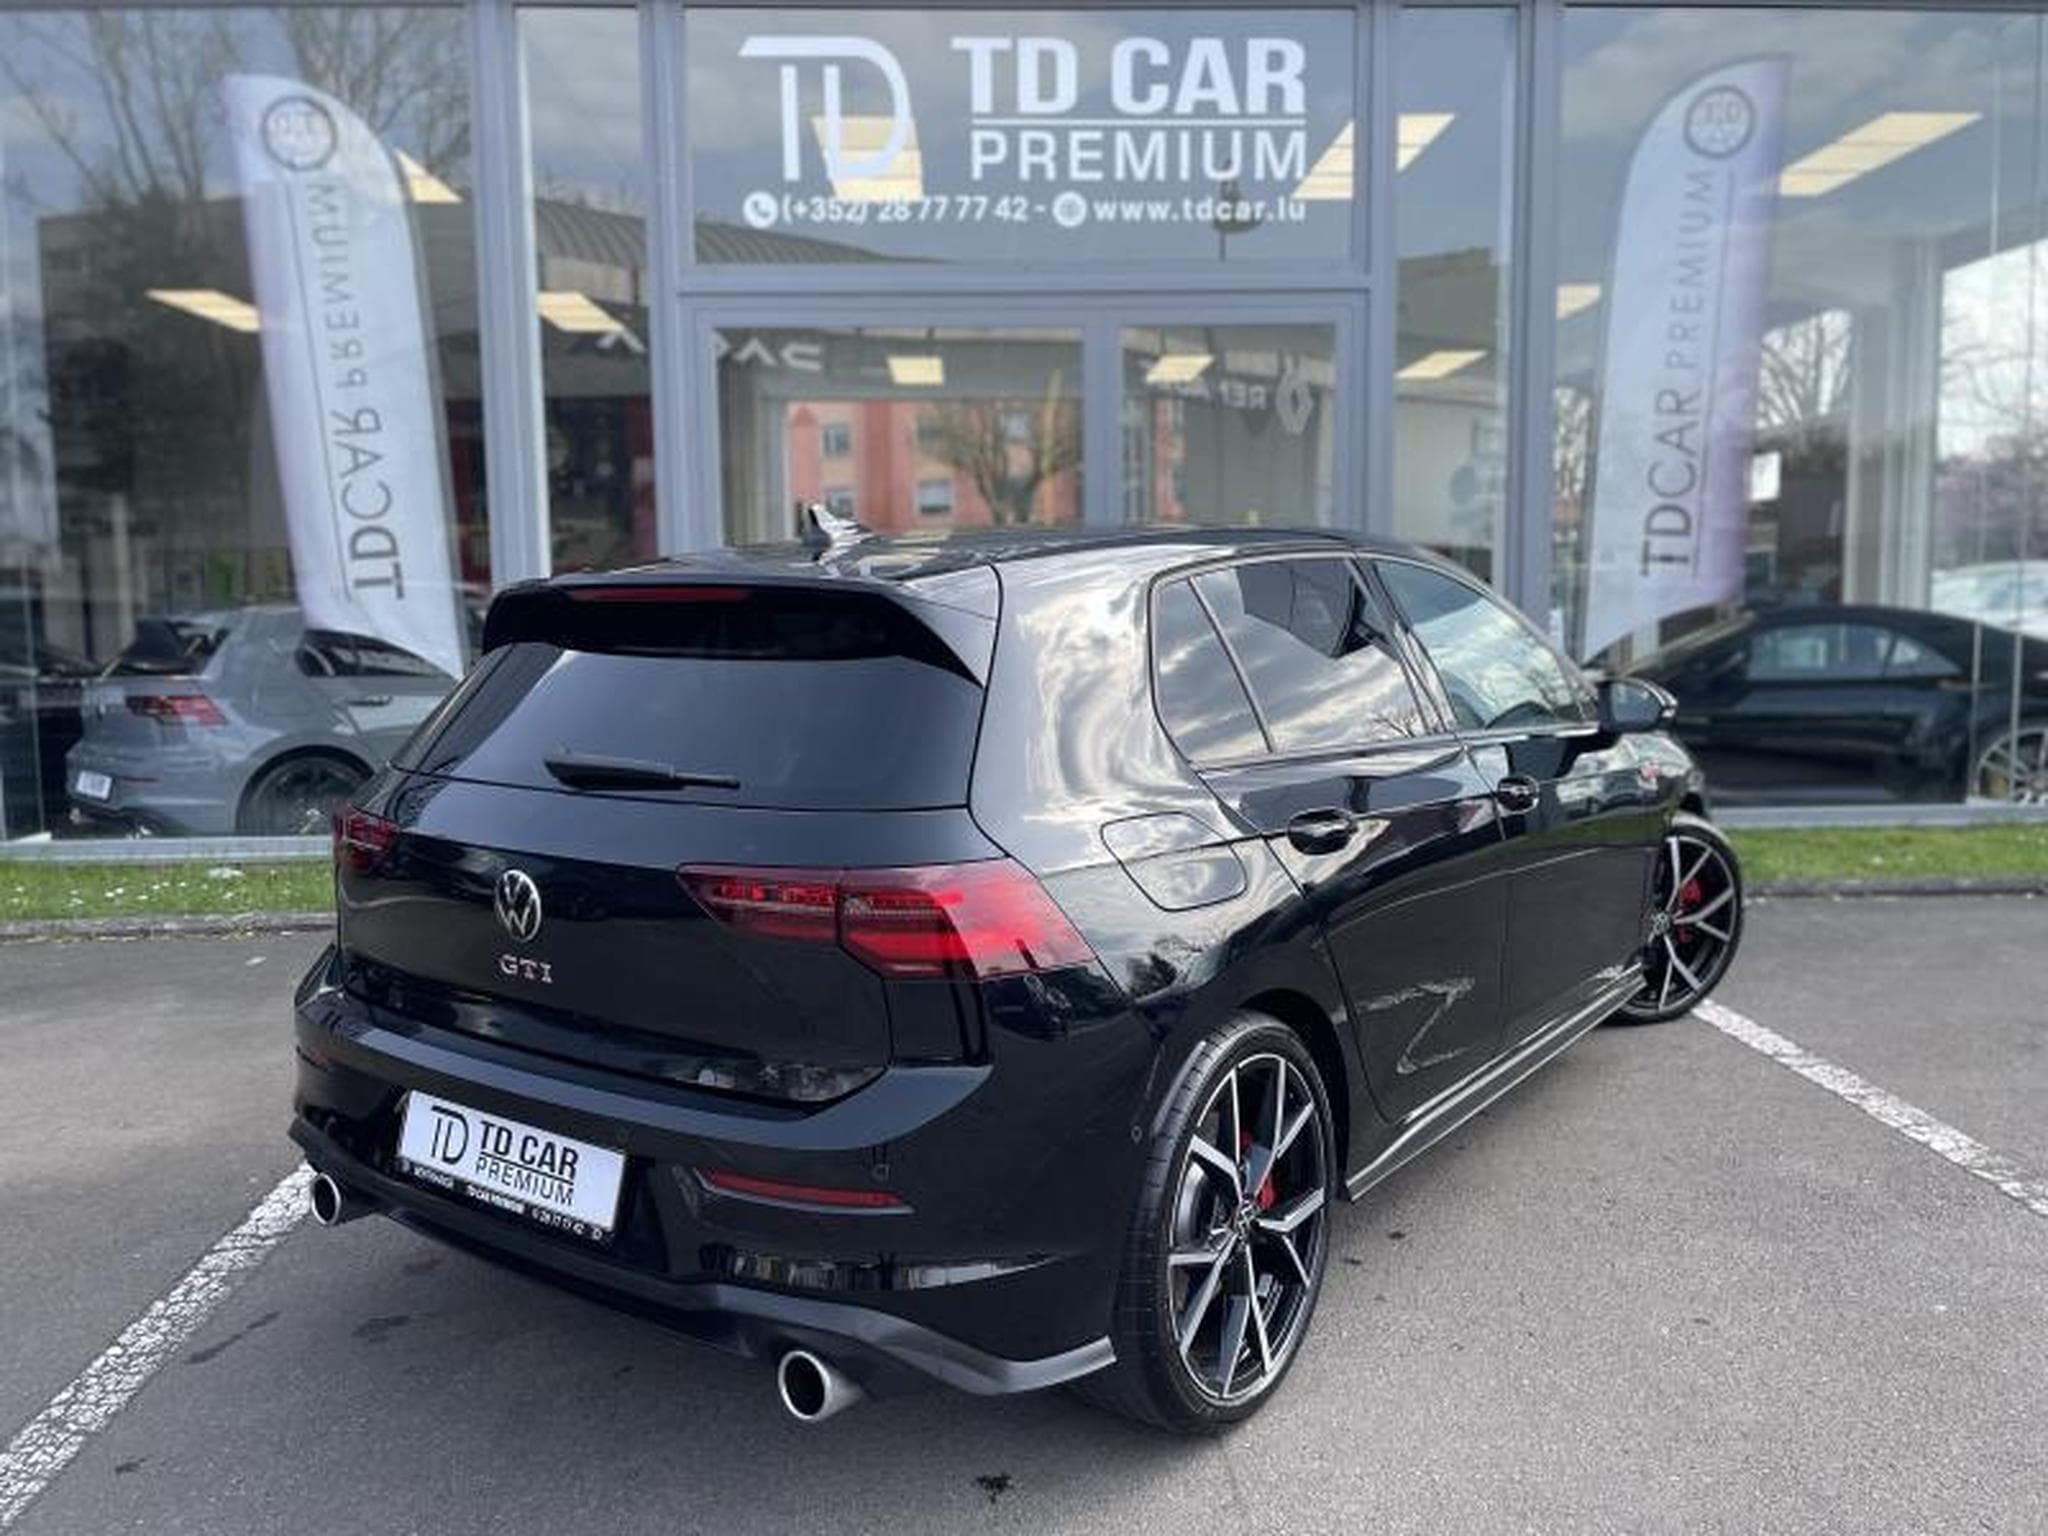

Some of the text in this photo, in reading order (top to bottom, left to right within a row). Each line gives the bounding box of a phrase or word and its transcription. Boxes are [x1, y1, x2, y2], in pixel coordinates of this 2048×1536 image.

[950, 36, 1306, 114] TD CAR
[971, 129, 1307, 181] PREMIUM
[955, 196, 988, 220] 77
[995, 196, 1028, 221] 42
[1093, 195, 1306, 221] www.tdcar.lu
[1640, 171, 1714, 579] TDCAR PREMIUM
[499, 954, 553, 984] GTI
[480, 1120, 579, 1180] TD CAR
[476, 1157, 574, 1206] PREMIUM
